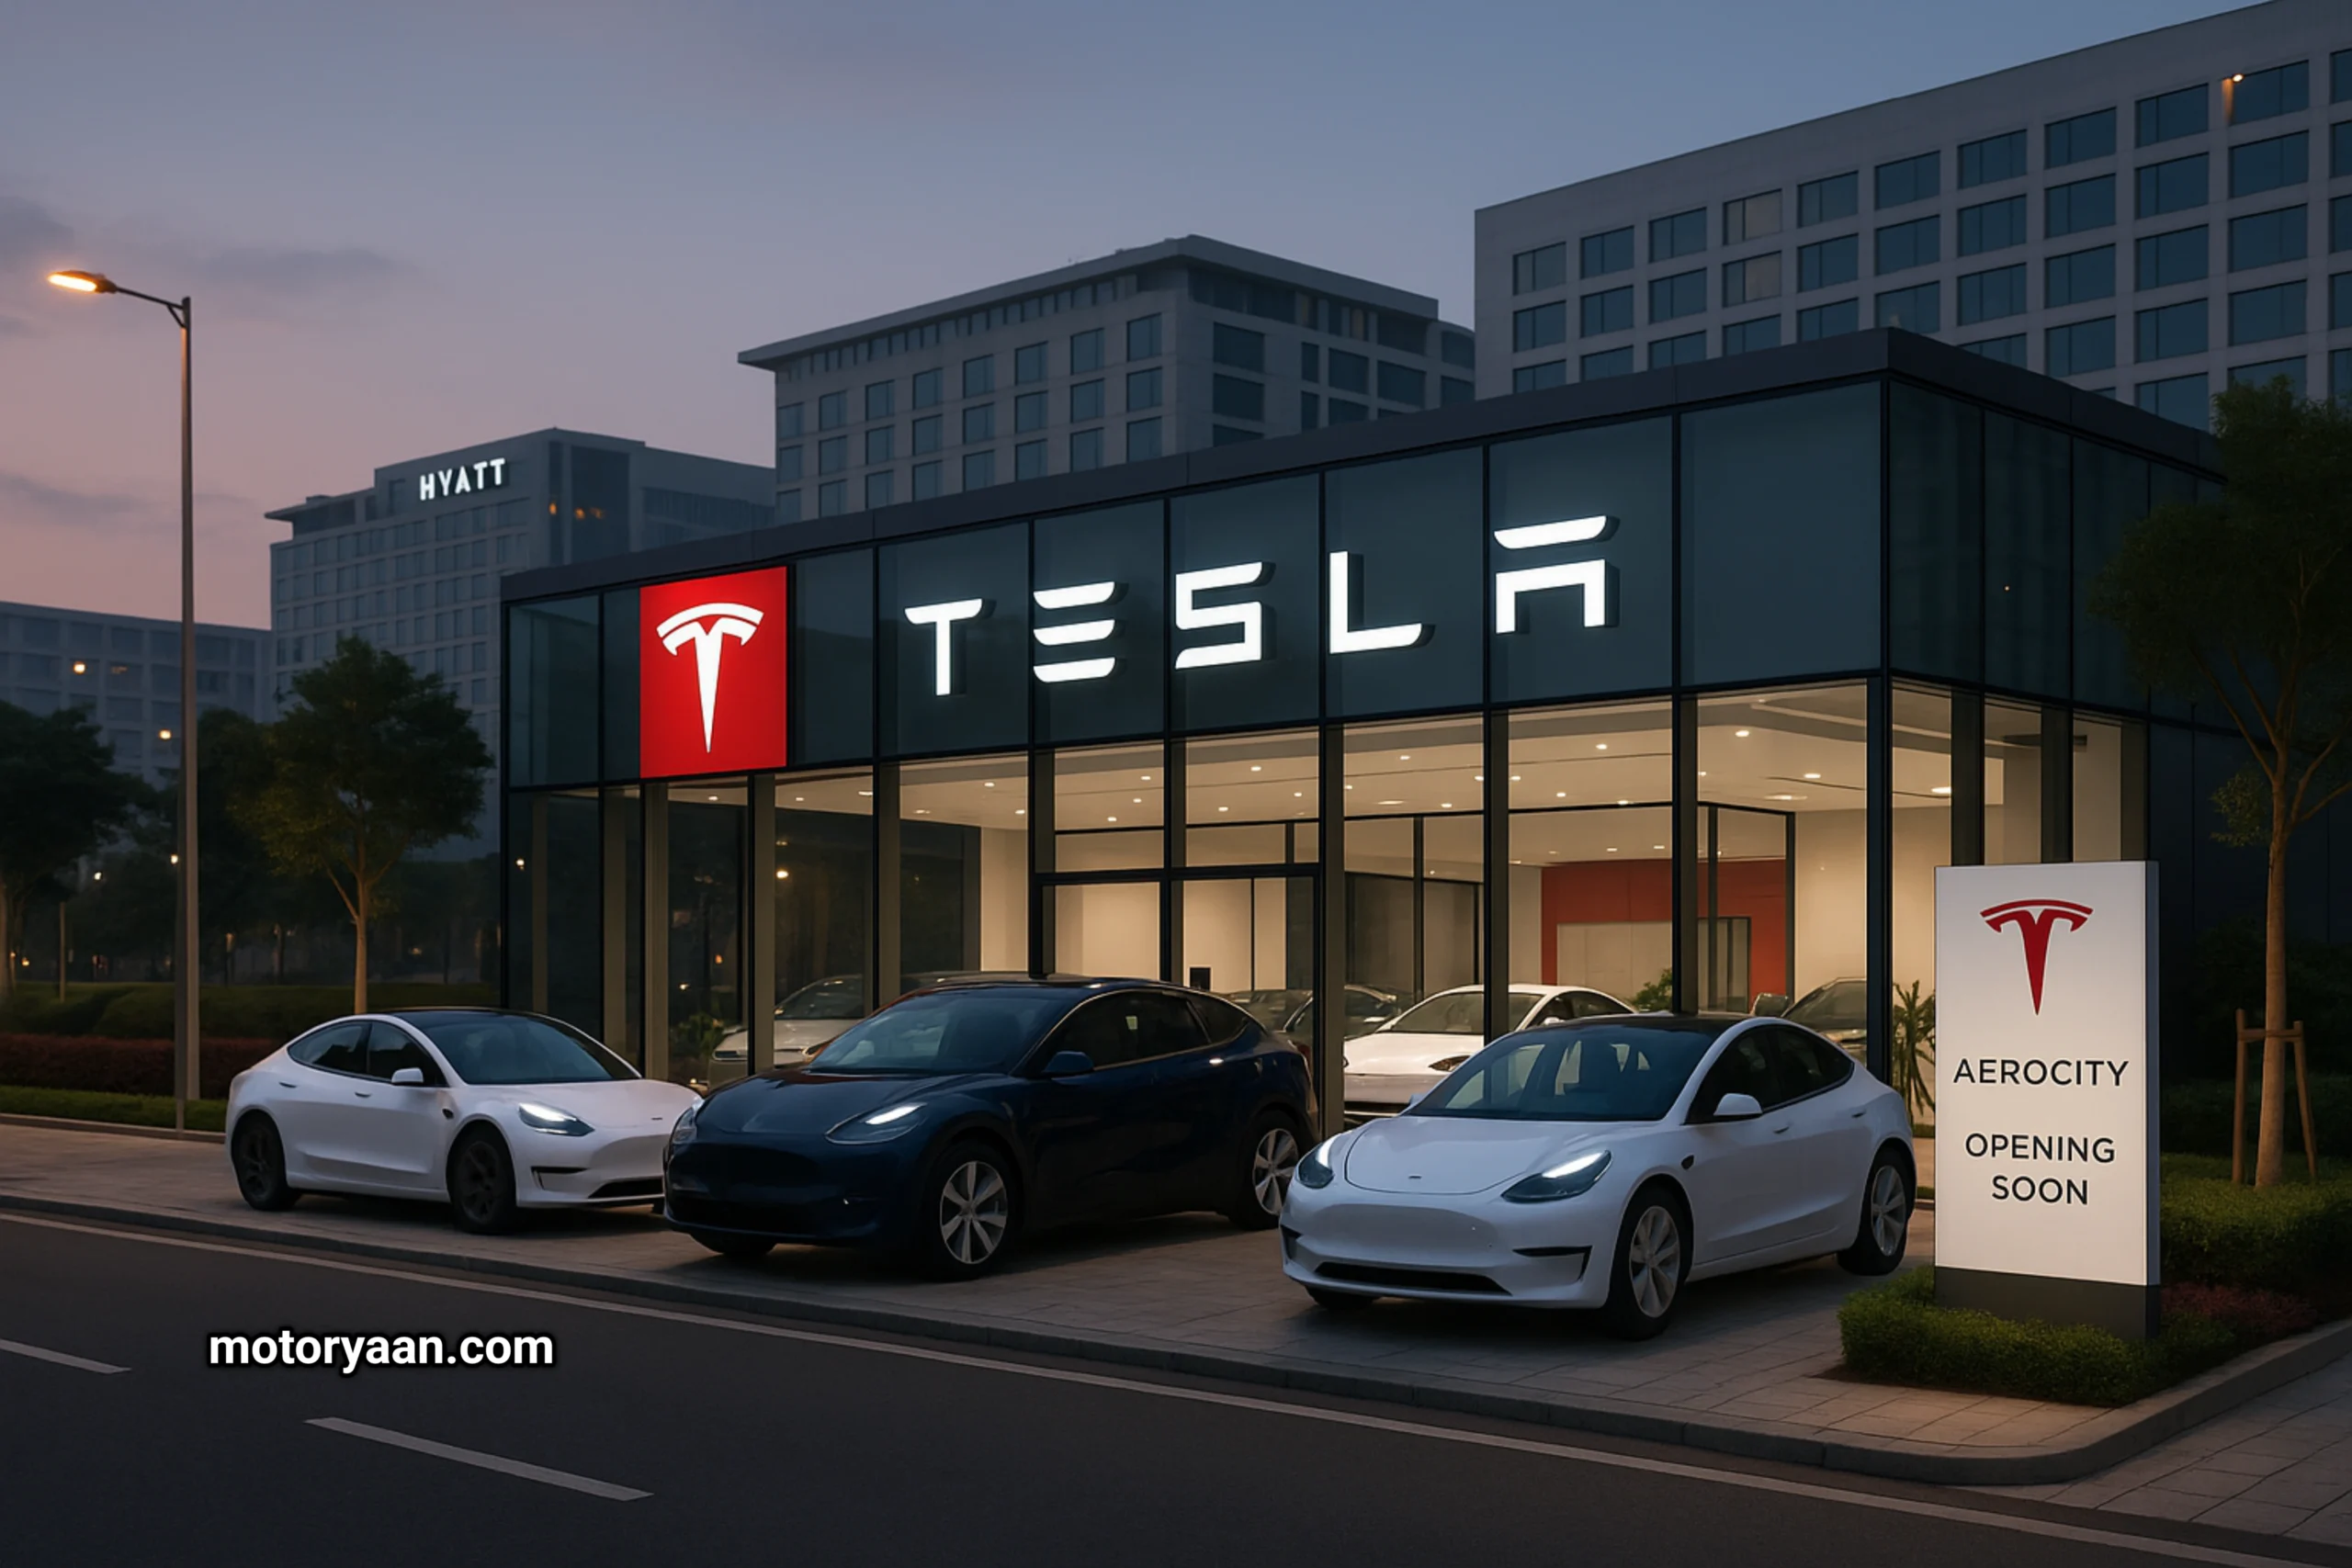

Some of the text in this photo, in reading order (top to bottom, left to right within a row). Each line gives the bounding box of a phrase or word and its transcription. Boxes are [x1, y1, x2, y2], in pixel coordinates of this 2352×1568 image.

[420, 457, 505, 501] HYATT
[904, 515, 1610, 696] TESLA
[1952, 1057, 2130, 1087] AEROCITY
[1964, 1132, 2116, 1164] OPENING
[1991, 1175, 2088, 1205] SOON
